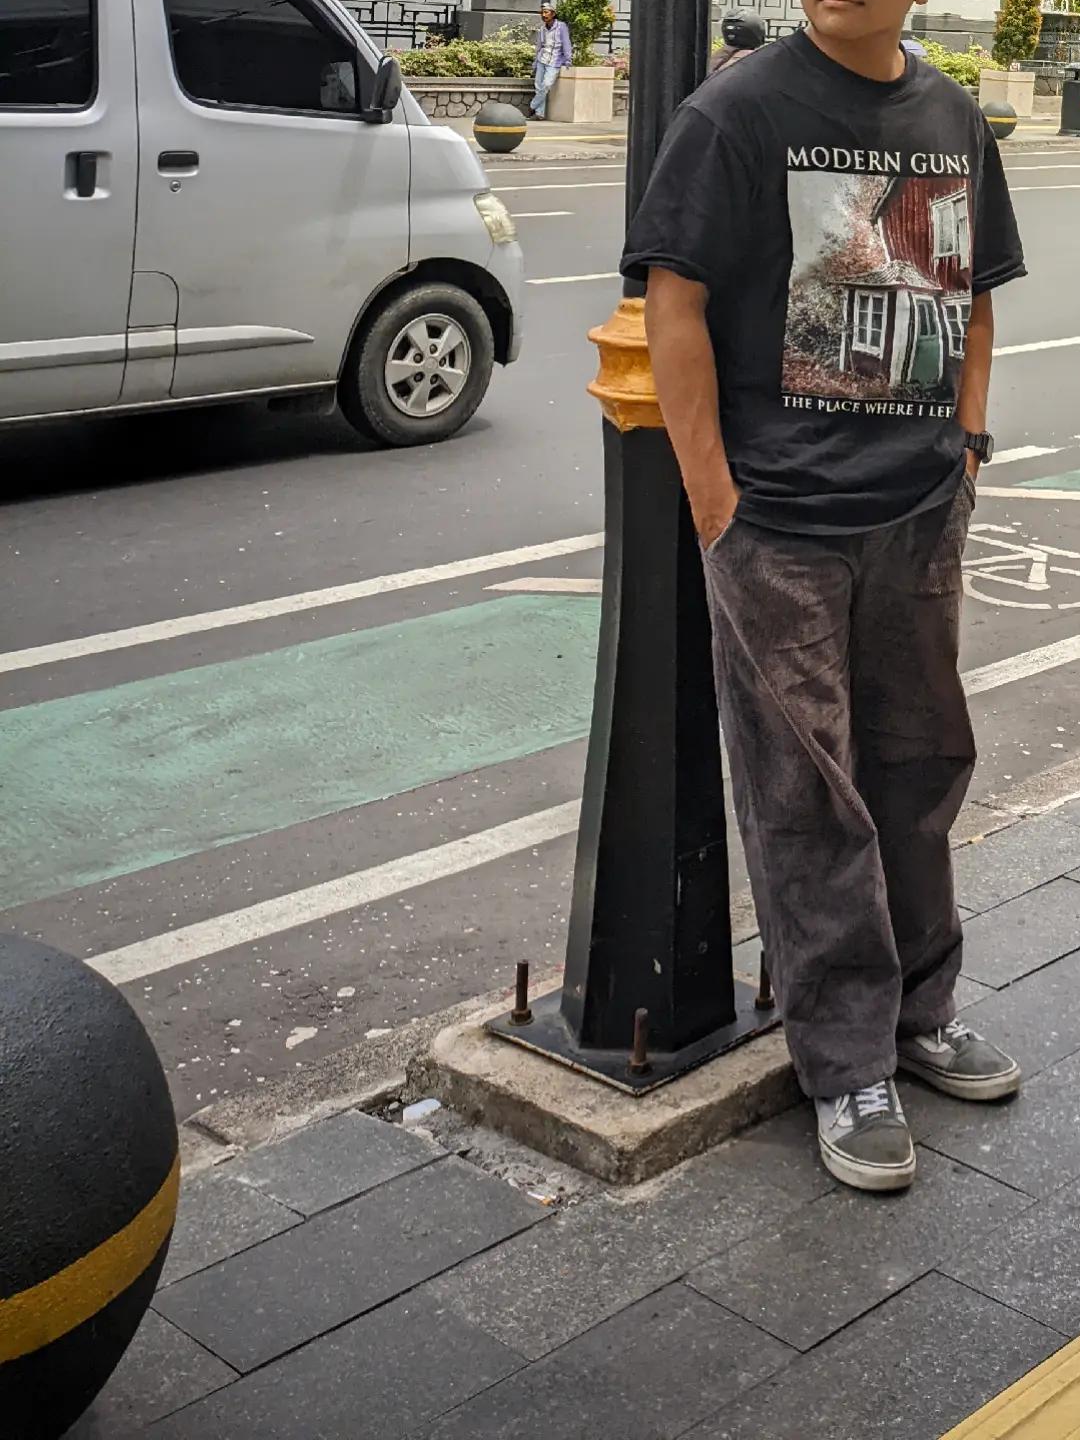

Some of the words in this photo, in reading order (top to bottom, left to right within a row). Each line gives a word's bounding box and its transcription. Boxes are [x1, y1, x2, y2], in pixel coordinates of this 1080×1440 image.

[787, 146, 901, 173] MODERN
[910, 152, 970, 175] GUNS
[782, 396, 813, 409] THE
[818, 399, 861, 413] PLACE
[865, 402, 914, 416] WHERE
[918, 404, 923, 417] I
